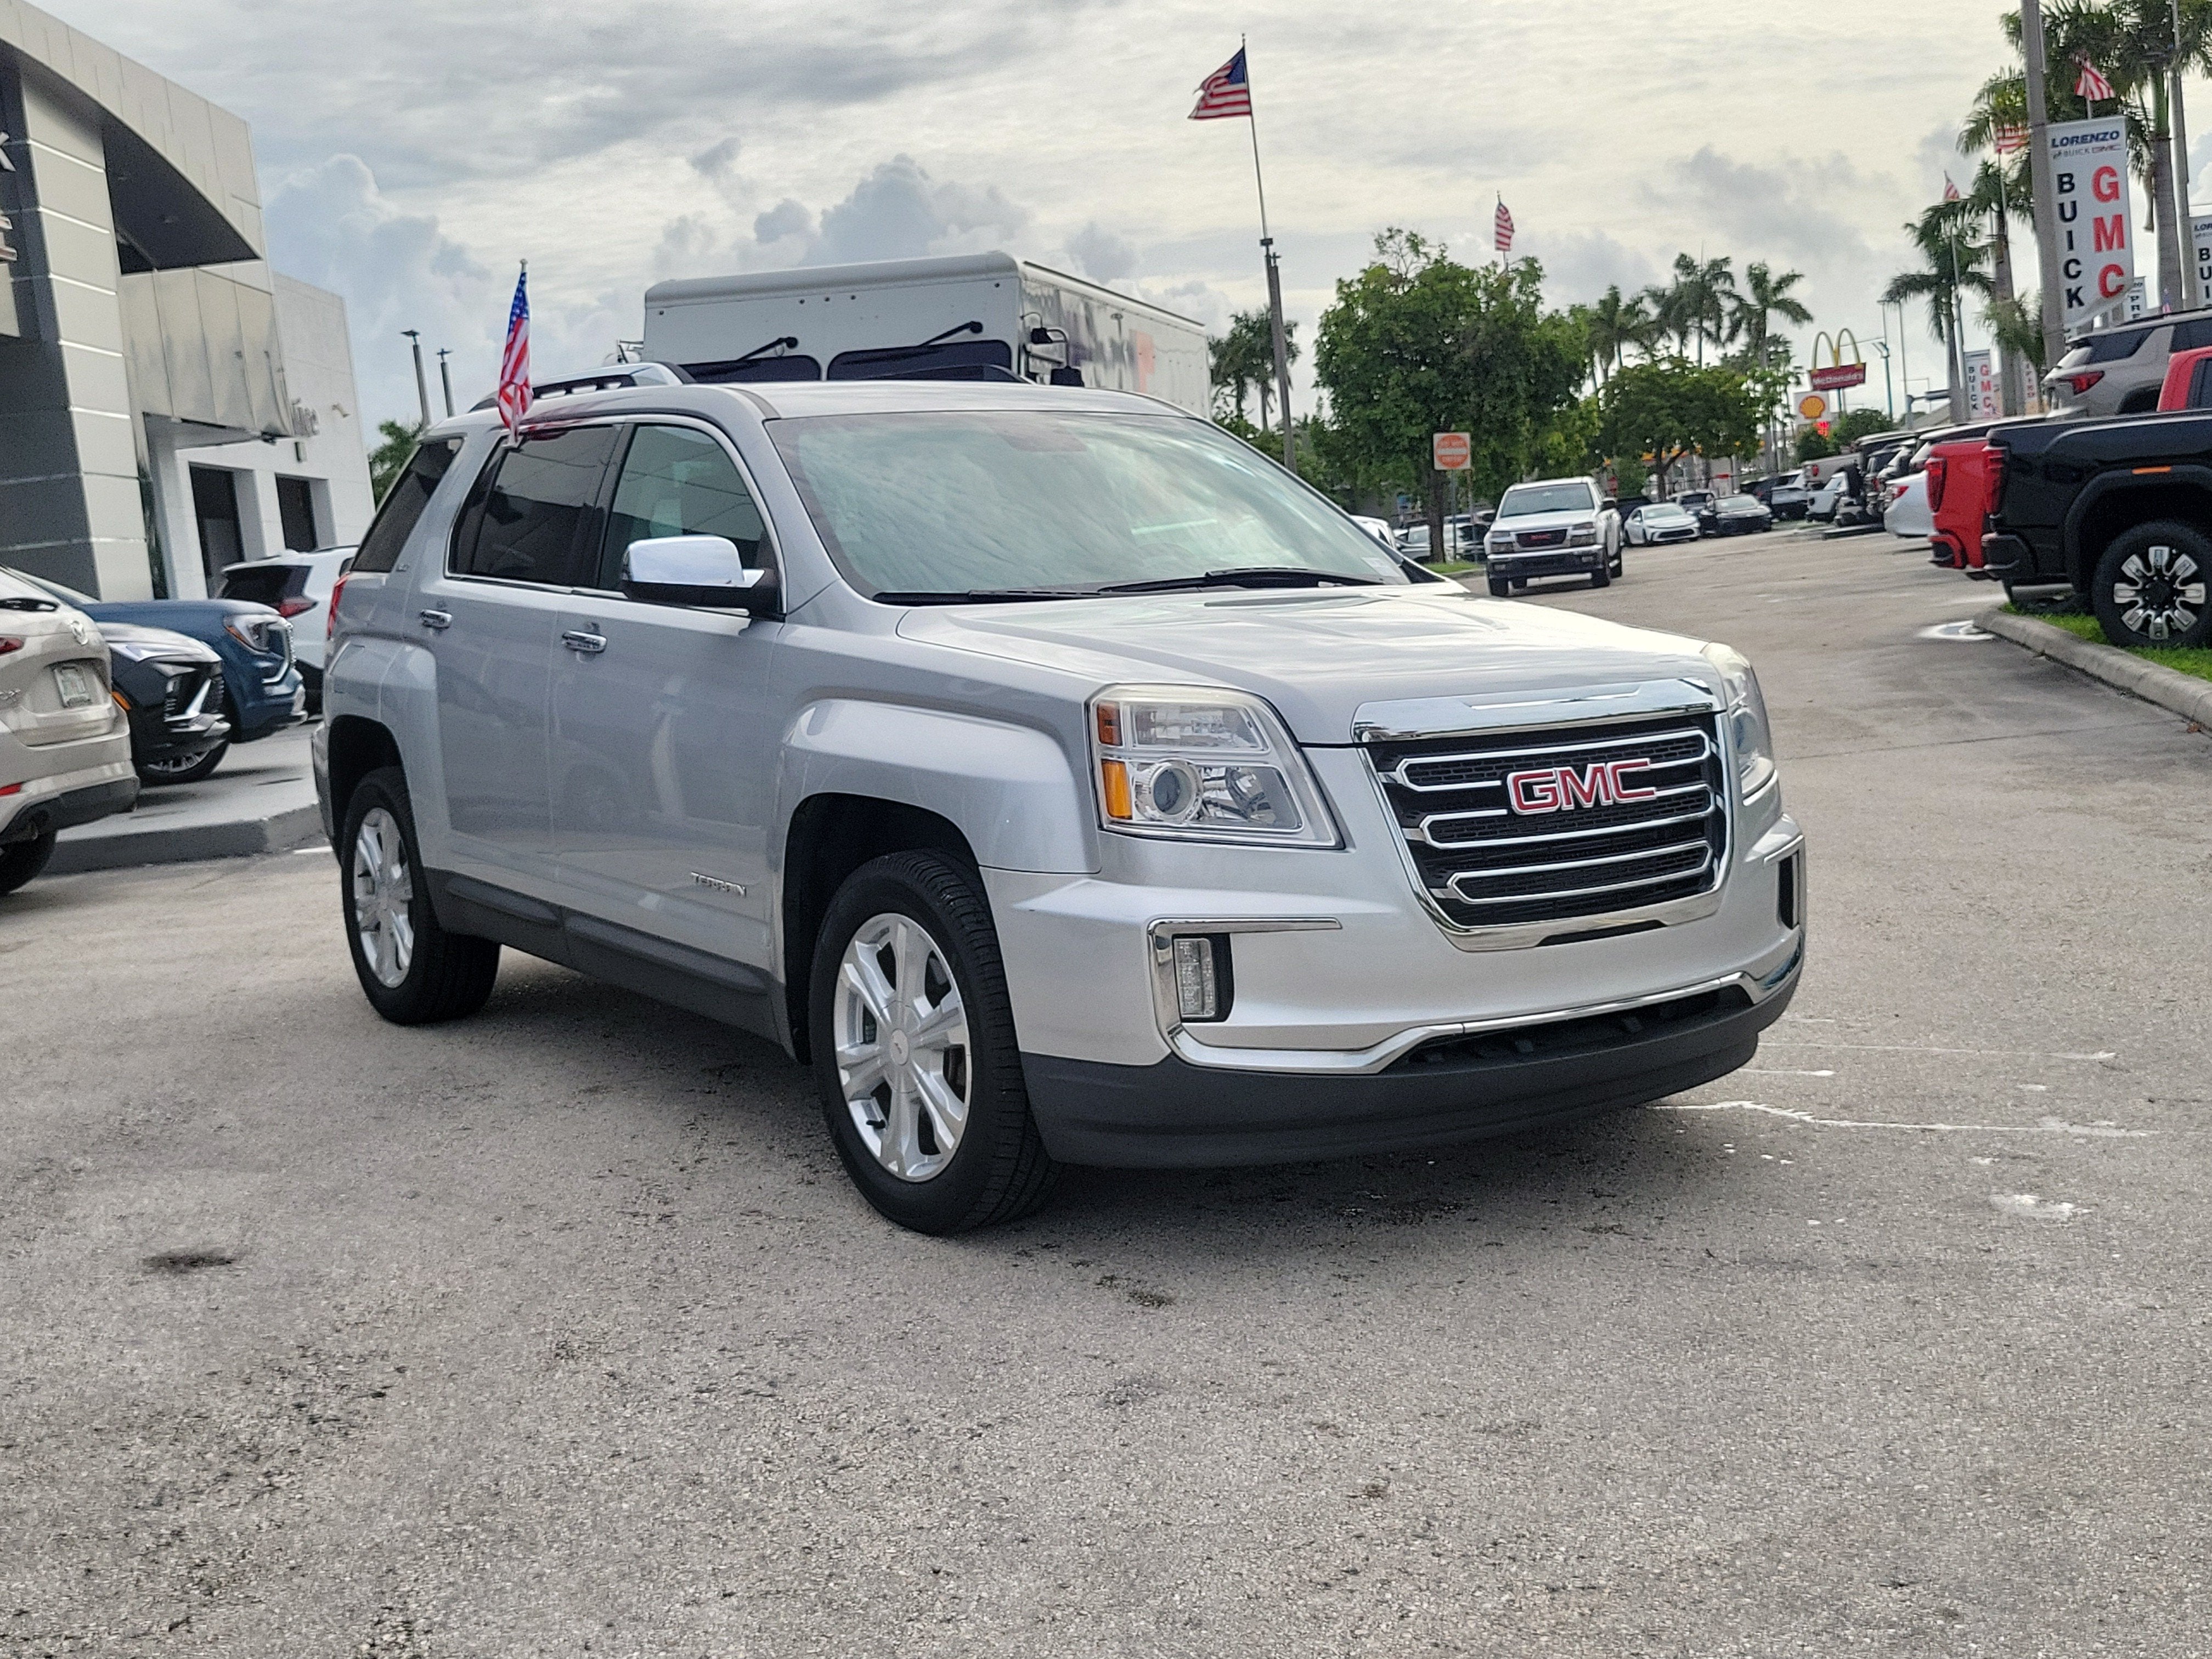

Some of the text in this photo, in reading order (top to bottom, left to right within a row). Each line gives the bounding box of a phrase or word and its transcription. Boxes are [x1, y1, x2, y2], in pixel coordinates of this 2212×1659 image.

[2051, 131, 2119, 148] LORENZO
[2057, 172, 2085, 309] BUICK
[2091, 165, 2125, 298] GMC
[1507, 758, 1656, 815] GMC
